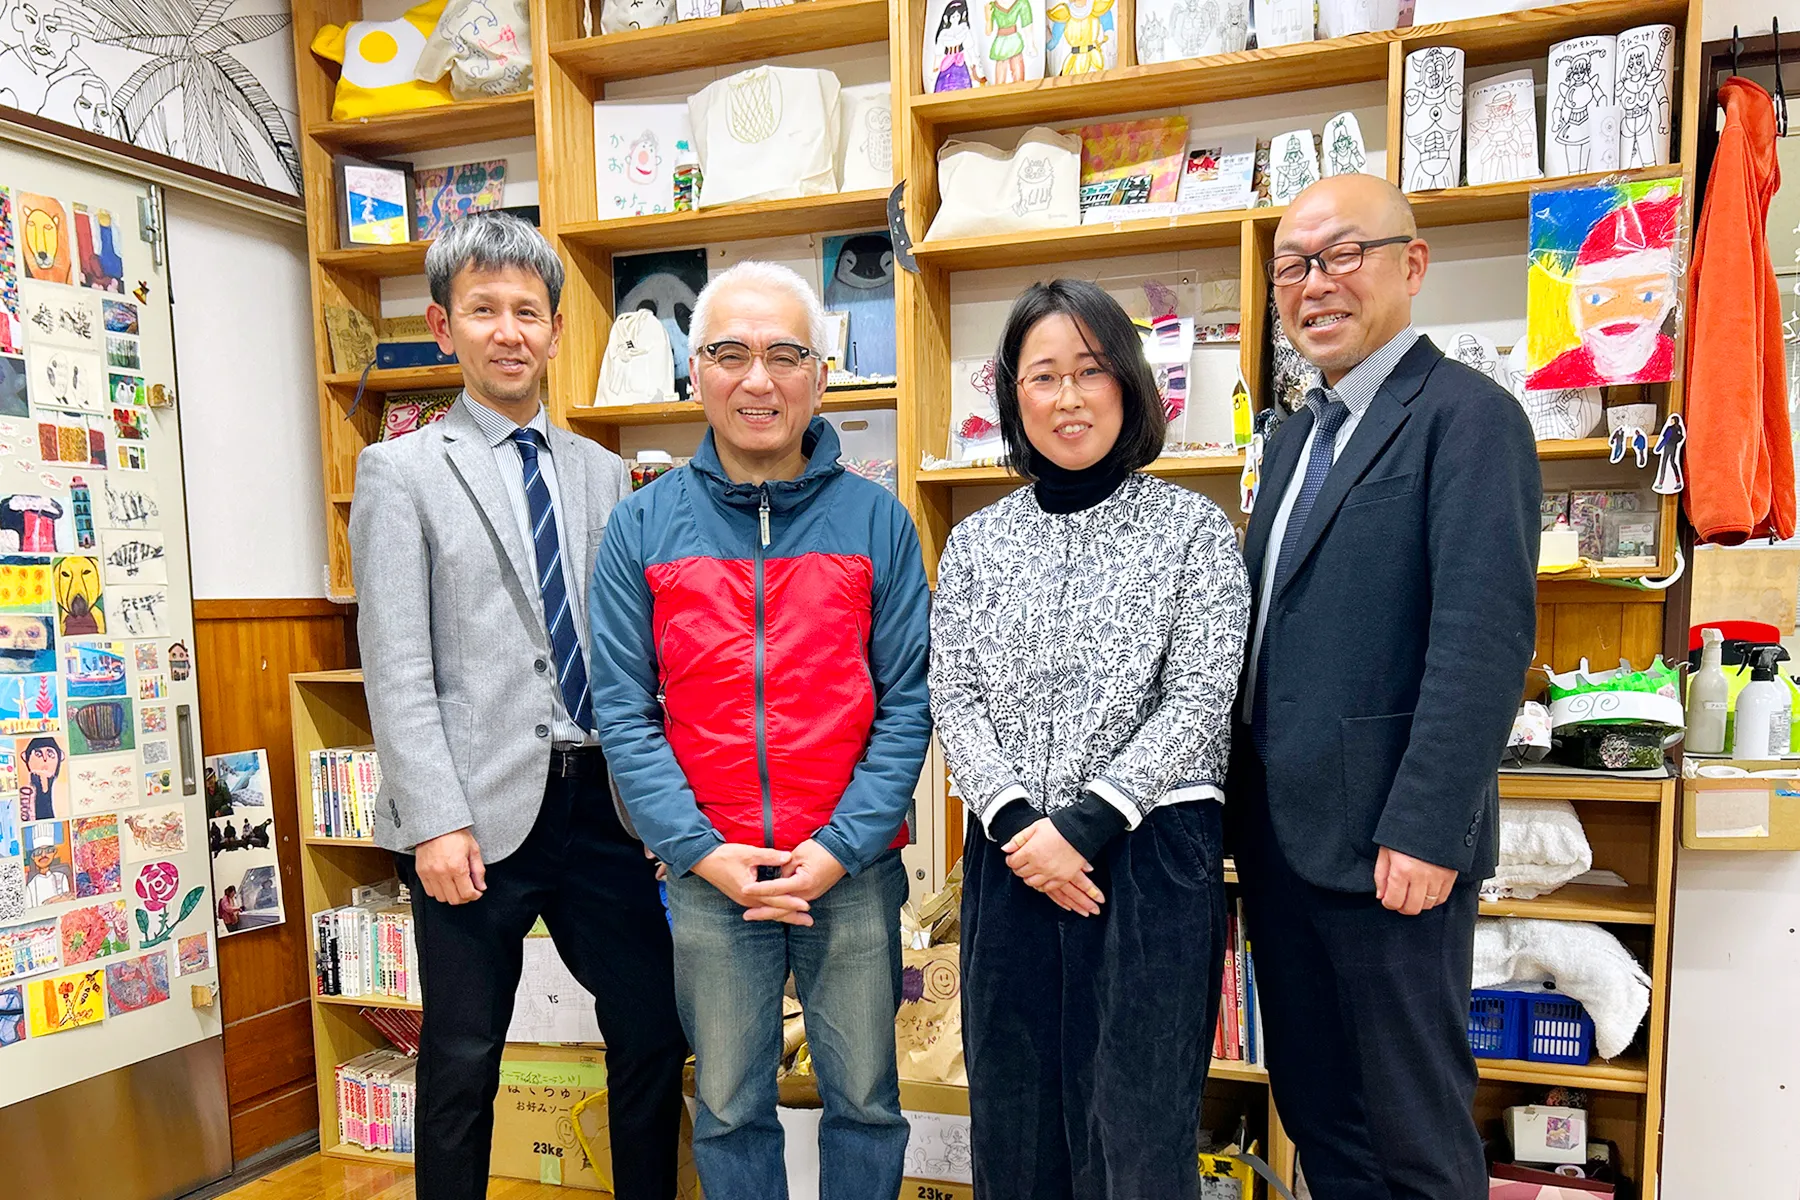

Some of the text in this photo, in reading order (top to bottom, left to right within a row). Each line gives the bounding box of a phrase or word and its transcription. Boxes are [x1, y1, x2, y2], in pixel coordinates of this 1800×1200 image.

[516, 1101, 572, 1114] お好みソー
[533, 1142, 563, 1157] 23kg
